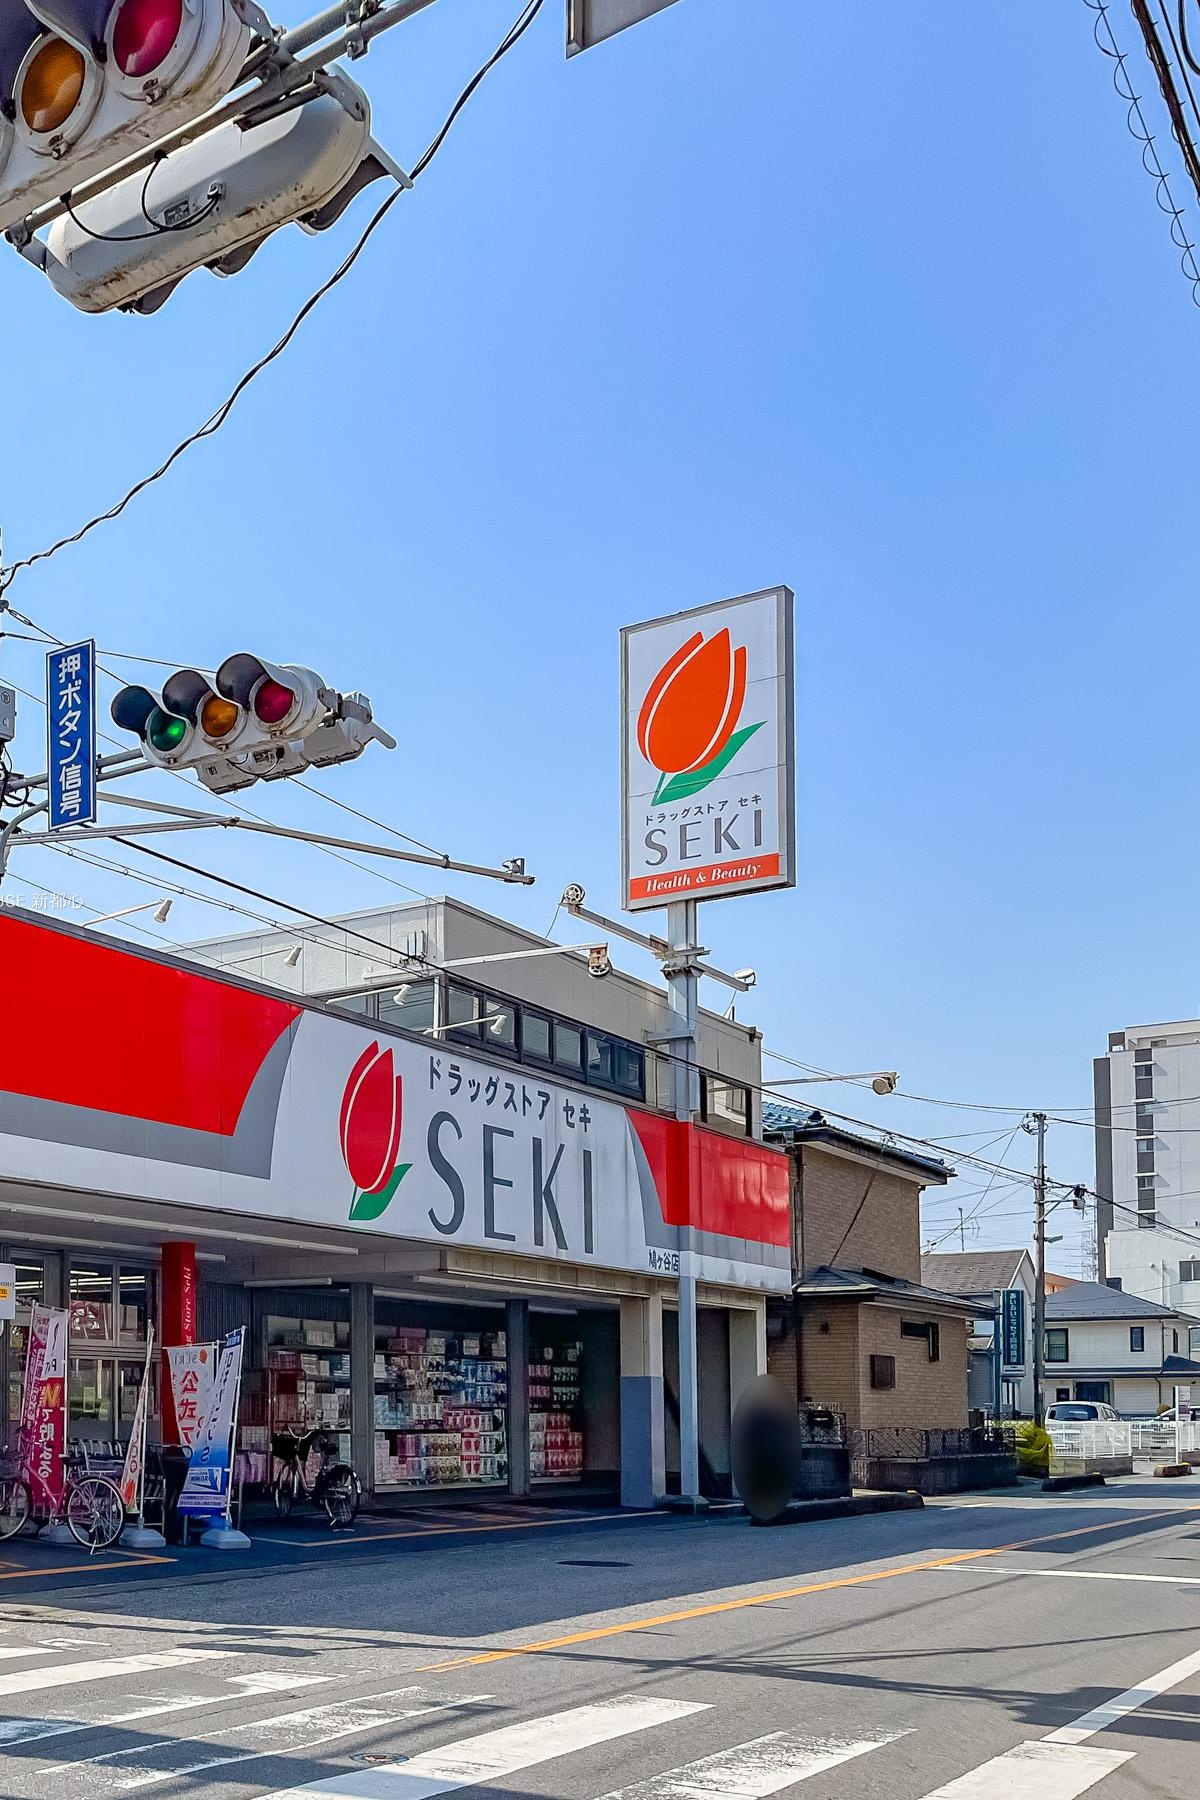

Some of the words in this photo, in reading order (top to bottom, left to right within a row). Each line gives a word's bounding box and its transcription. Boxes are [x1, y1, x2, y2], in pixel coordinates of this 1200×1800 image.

[58, 652, 82, 817] 押ボタン信号
[645, 800, 729, 826] ドラッグストア
[738, 794, 762, 808] セキ
[645, 809, 762, 867] SEKI
[646, 874, 691, 893] Health
[695, 871, 707, 884] &
[711, 863, 762, 881] Beauty
[430, 1055, 551, 1121] ドラッグストア
[563, 1098, 591, 1133] セキ
[427, 1111, 594, 1255] SEKI
